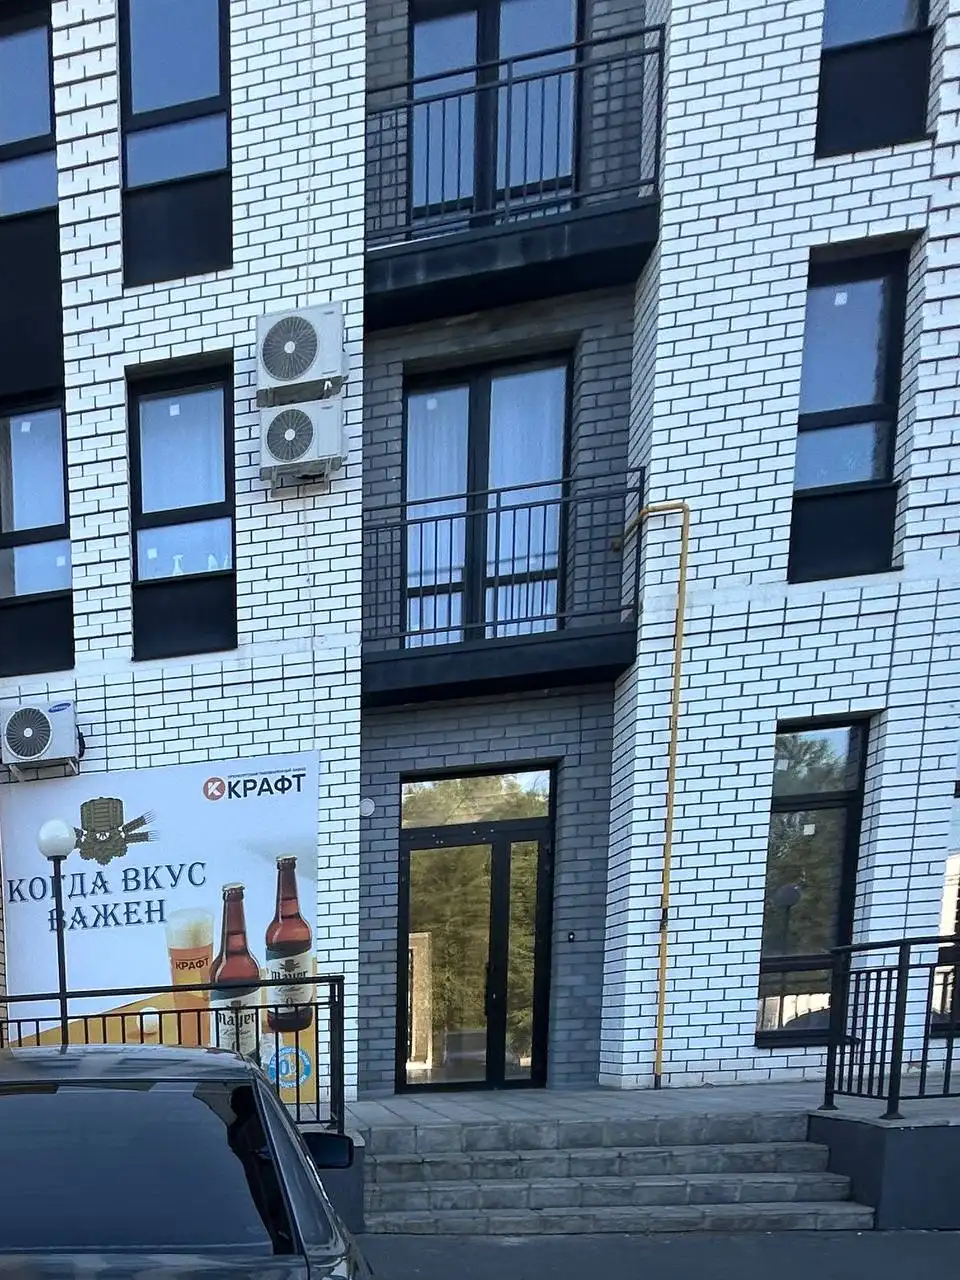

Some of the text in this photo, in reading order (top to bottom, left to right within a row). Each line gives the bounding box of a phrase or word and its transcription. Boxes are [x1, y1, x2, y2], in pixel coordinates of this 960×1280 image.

[228, 773, 306, 799] КРАФТ
[122, 861, 207, 893] ВКУС
[48, 899, 168, 933] ВАЖЕН
[175, 957, 209, 971] КРАФТ
